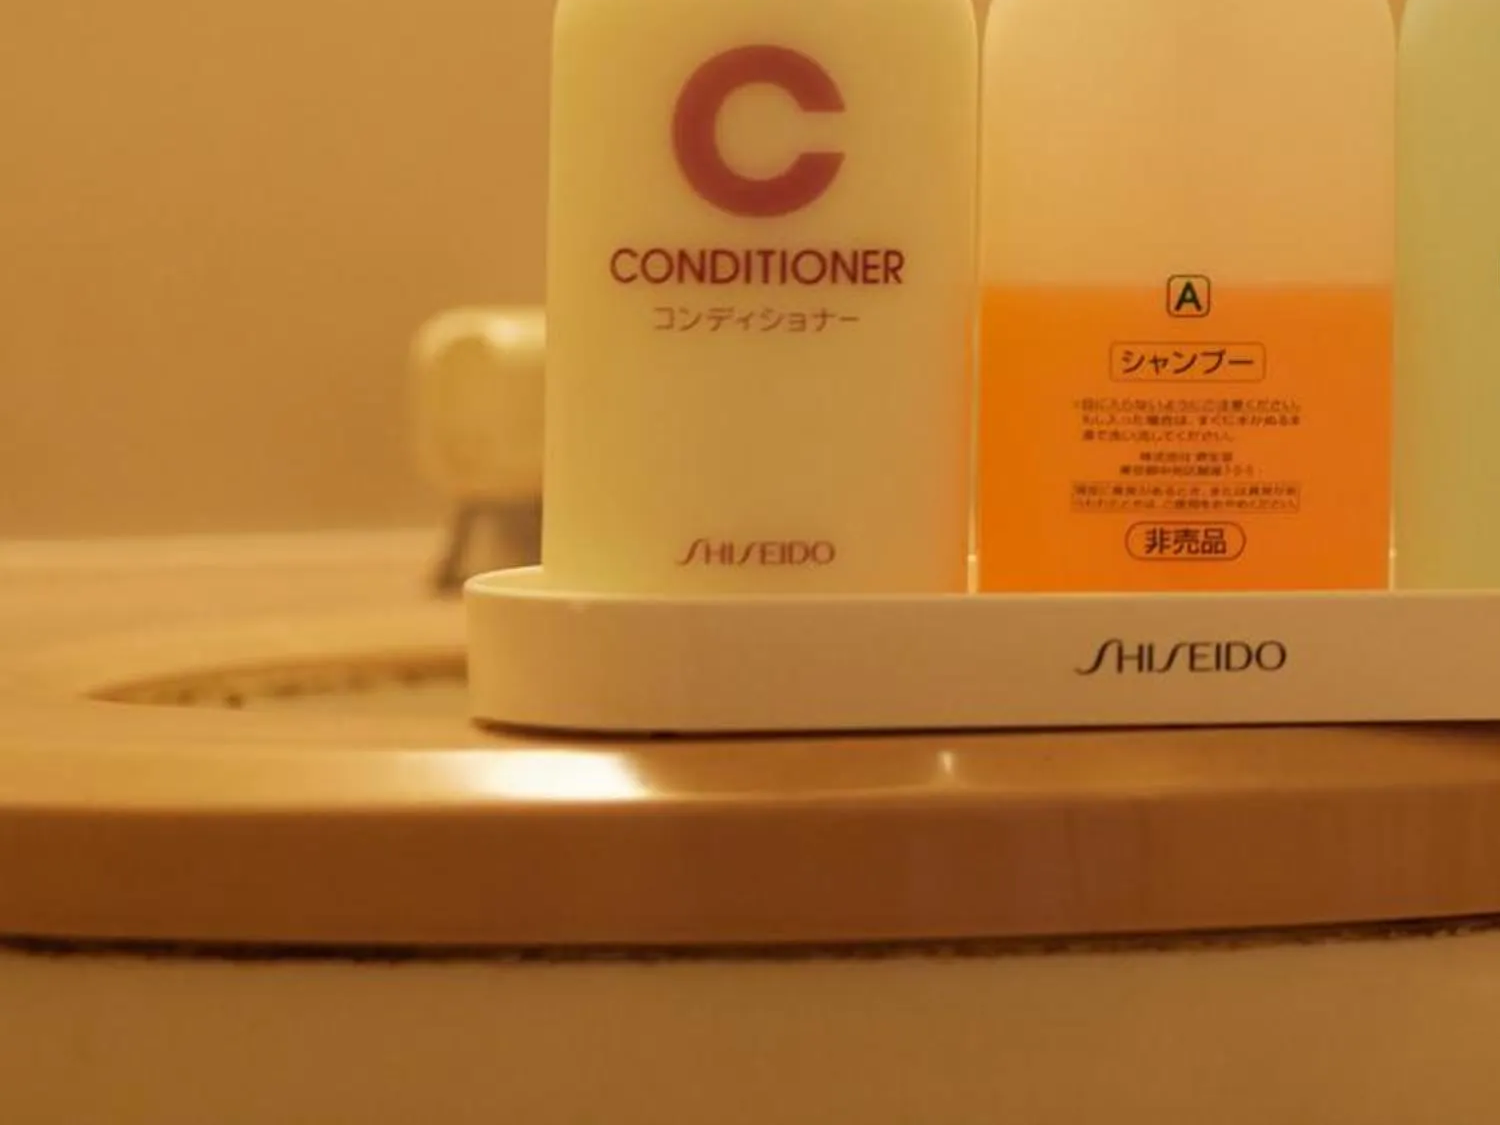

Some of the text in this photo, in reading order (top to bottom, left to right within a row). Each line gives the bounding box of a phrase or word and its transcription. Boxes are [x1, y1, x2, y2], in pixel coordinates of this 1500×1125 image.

[671, 43, 845, 217] C
[609, 247, 906, 286] CONDITIONER
[1174, 280, 1203, 312] A
[653, 306, 860, 332] コンディショナー
[1121, 348, 1255, 375] シャンプー
[675, 538, 837, 567] SHISEIDO
[1145, 527, 1227, 556] 非売品
[1073, 637, 1288, 676] SHISEIDO
